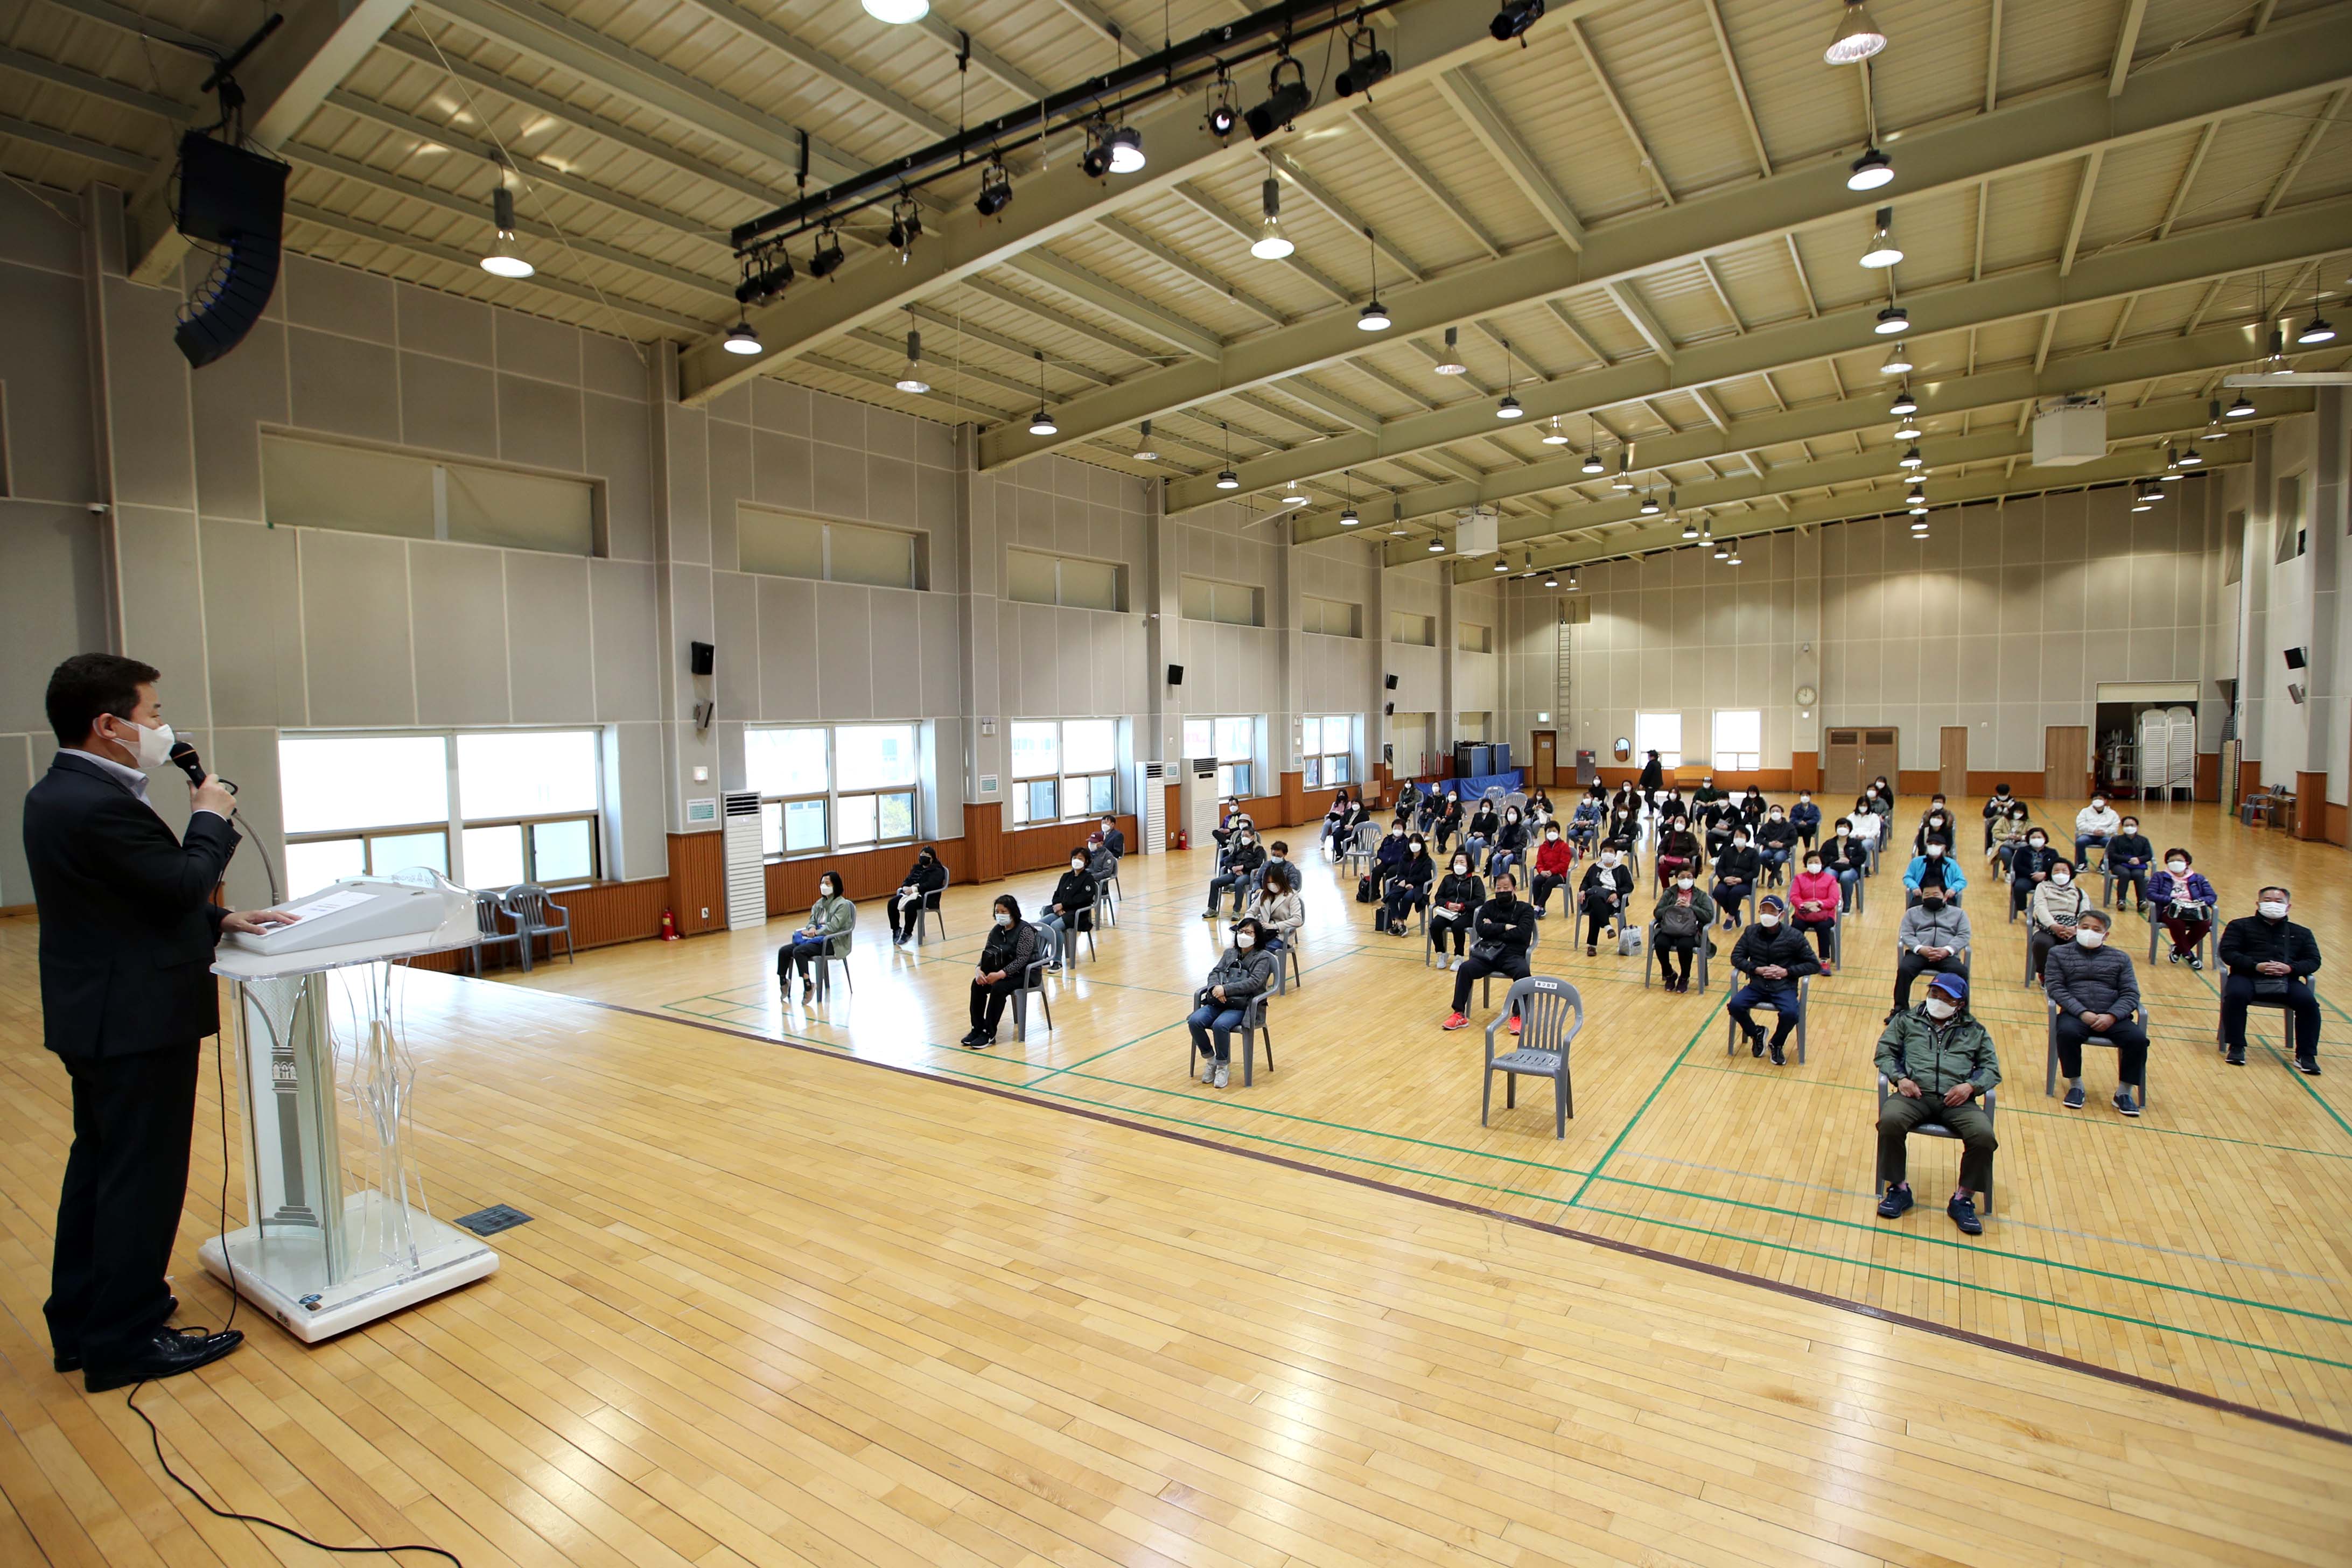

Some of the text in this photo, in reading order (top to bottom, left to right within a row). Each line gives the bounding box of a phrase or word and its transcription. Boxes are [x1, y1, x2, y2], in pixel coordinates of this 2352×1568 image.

[1224, 26, 1231, 39] 2
[1104, 76, 1108, 87] 1
[997, 119, 1003, 130] 4
[906, 157, 911, 168] 3
[826, 190, 831, 200] 2
